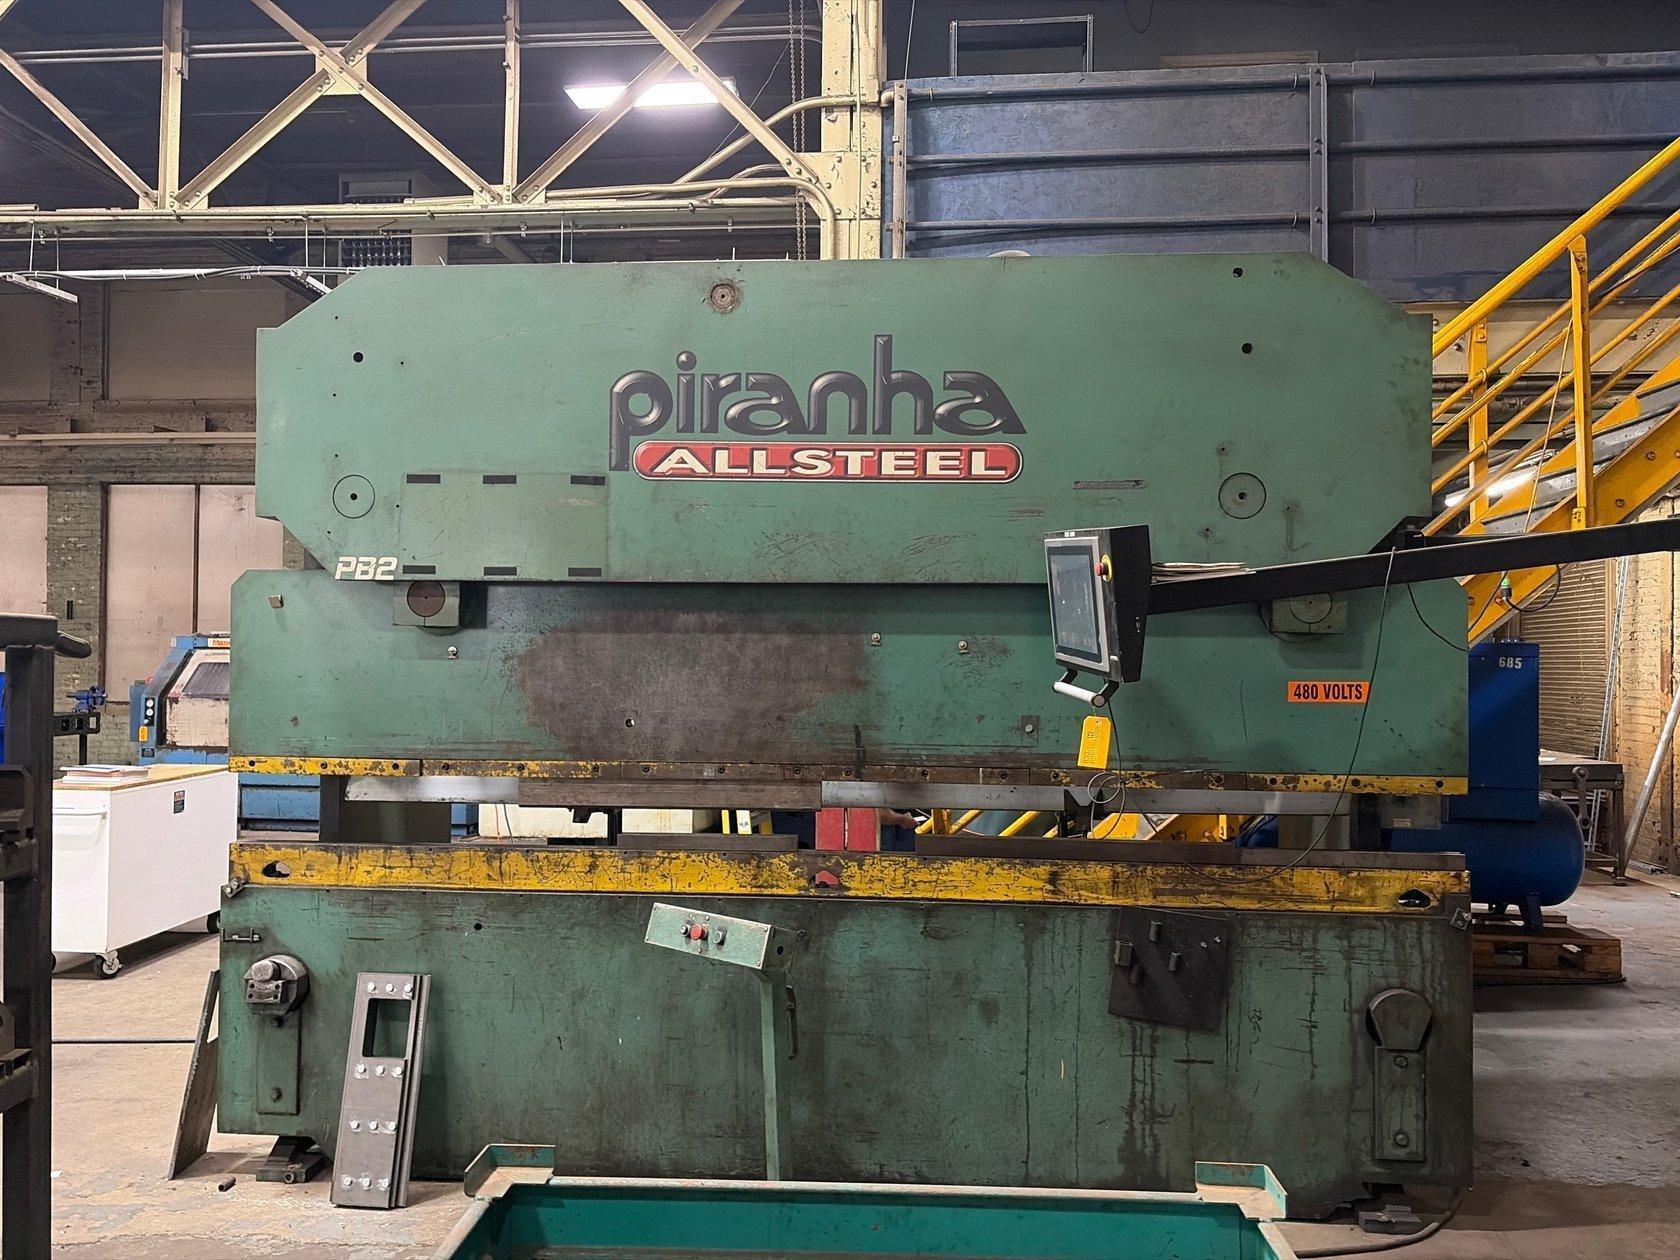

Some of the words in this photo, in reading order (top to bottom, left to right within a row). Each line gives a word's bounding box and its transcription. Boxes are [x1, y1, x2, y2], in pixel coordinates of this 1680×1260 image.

[609, 334, 1027, 471] piranha
[651, 448, 1007, 477] ALLSTEEL
[334, 556, 398, 580] PB2
[1499, 656, 1522, 669] 685
[1293, 683, 1319, 700] 480
[1323, 683, 1363, 700] VOLTS
